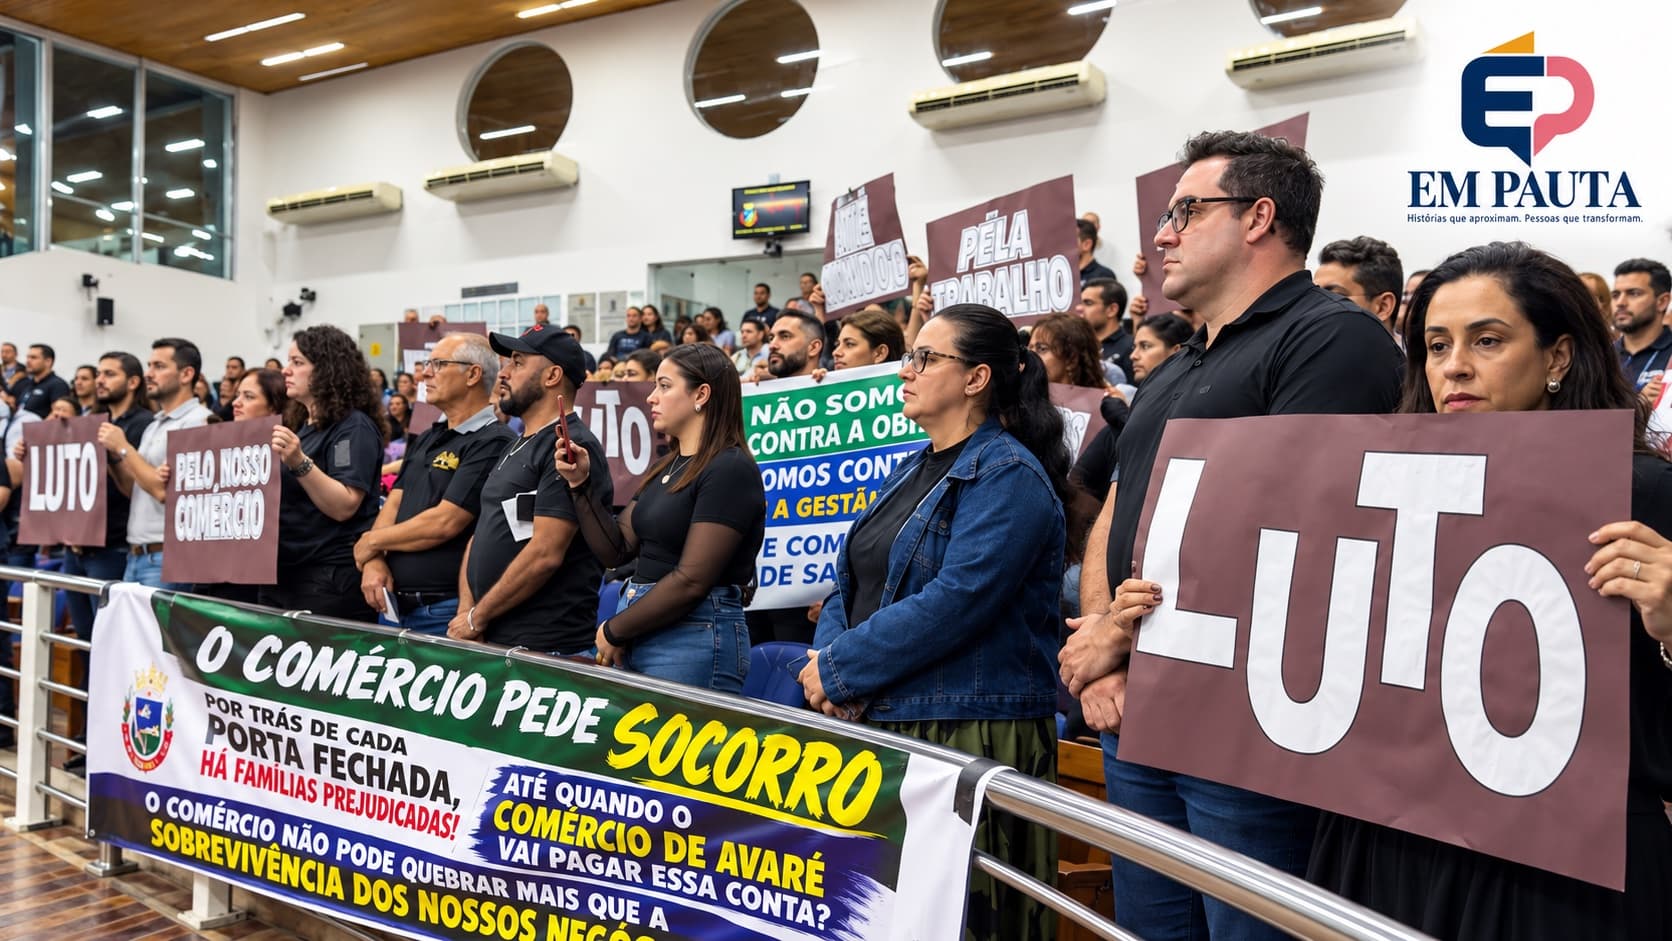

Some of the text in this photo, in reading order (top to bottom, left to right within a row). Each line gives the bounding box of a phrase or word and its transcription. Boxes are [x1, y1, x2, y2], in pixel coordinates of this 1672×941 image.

[747, 422, 841, 456] CONTRA
[847, 418, 864, 444] A
[750, 396, 817, 426] NÃO
[29, 441, 98, 512] LUTO
[838, 451, 917, 484] CONT
[772, 498, 790, 520] A
[760, 565, 794, 588] DE
[1136, 450, 1587, 797] LUTO
[195, 625, 883, 827] O COMÉRCIO PEDE SOCORRO
[205, 692, 408, 756] POR TRÁS DE CADA
[205, 713, 304, 770] PORTA
[313, 742, 461, 811] FECHADA,
[200, 748, 461, 841] HÁ FAMÍLIAS PREJUDICADAS!
[502, 772, 692, 829] ATÉ QUANDO O
[145, 791, 670, 932] O COMÉRCIO NÃO PODE QUEBRAR MAIS QUE A
[150, 818, 345, 901] SOBREVIVÊNCIA
[352, 871, 410, 917] DOS
[418, 889, 537, 941] NOSSOS
[493, 799, 826, 898] COMÉRCIO DE AVARÉ
[498, 835, 832, 931] VAI PAGAR ESSA CONTA?
